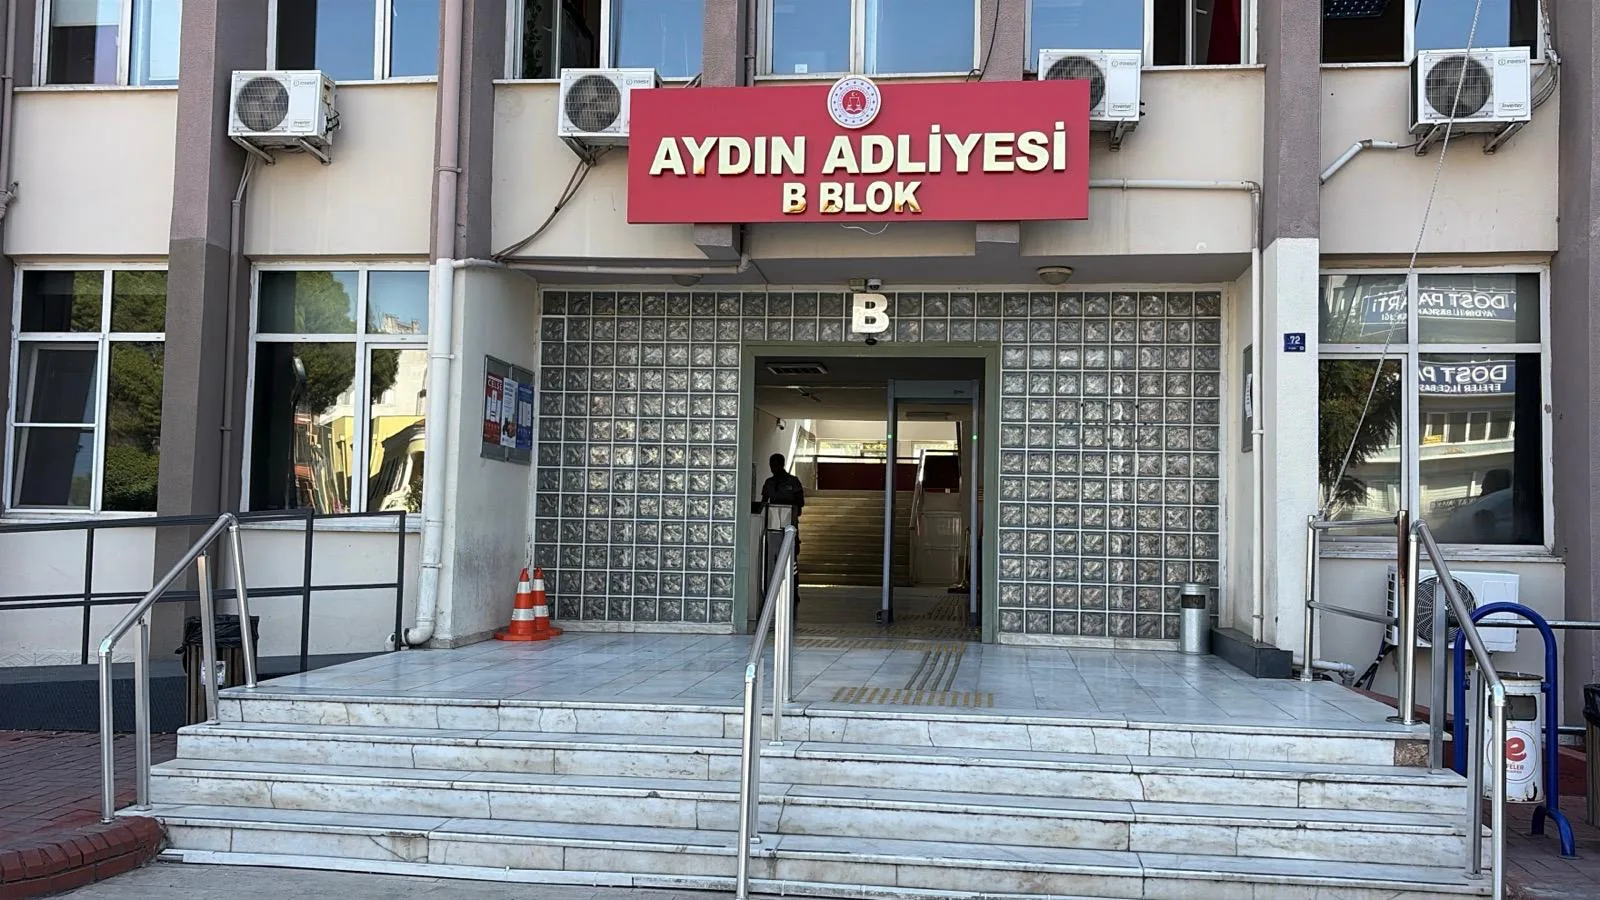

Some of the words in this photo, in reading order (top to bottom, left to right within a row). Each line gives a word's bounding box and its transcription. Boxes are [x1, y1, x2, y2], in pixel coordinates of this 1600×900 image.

[649, 135, 806, 176] AYDIN
[821, 121, 1067, 175] ADLİYESİ
[782, 182, 808, 214] B
[819, 181, 923, 214] BLOK
[851, 293, 890, 334] B
[1289, 335, 1302, 345] 72
